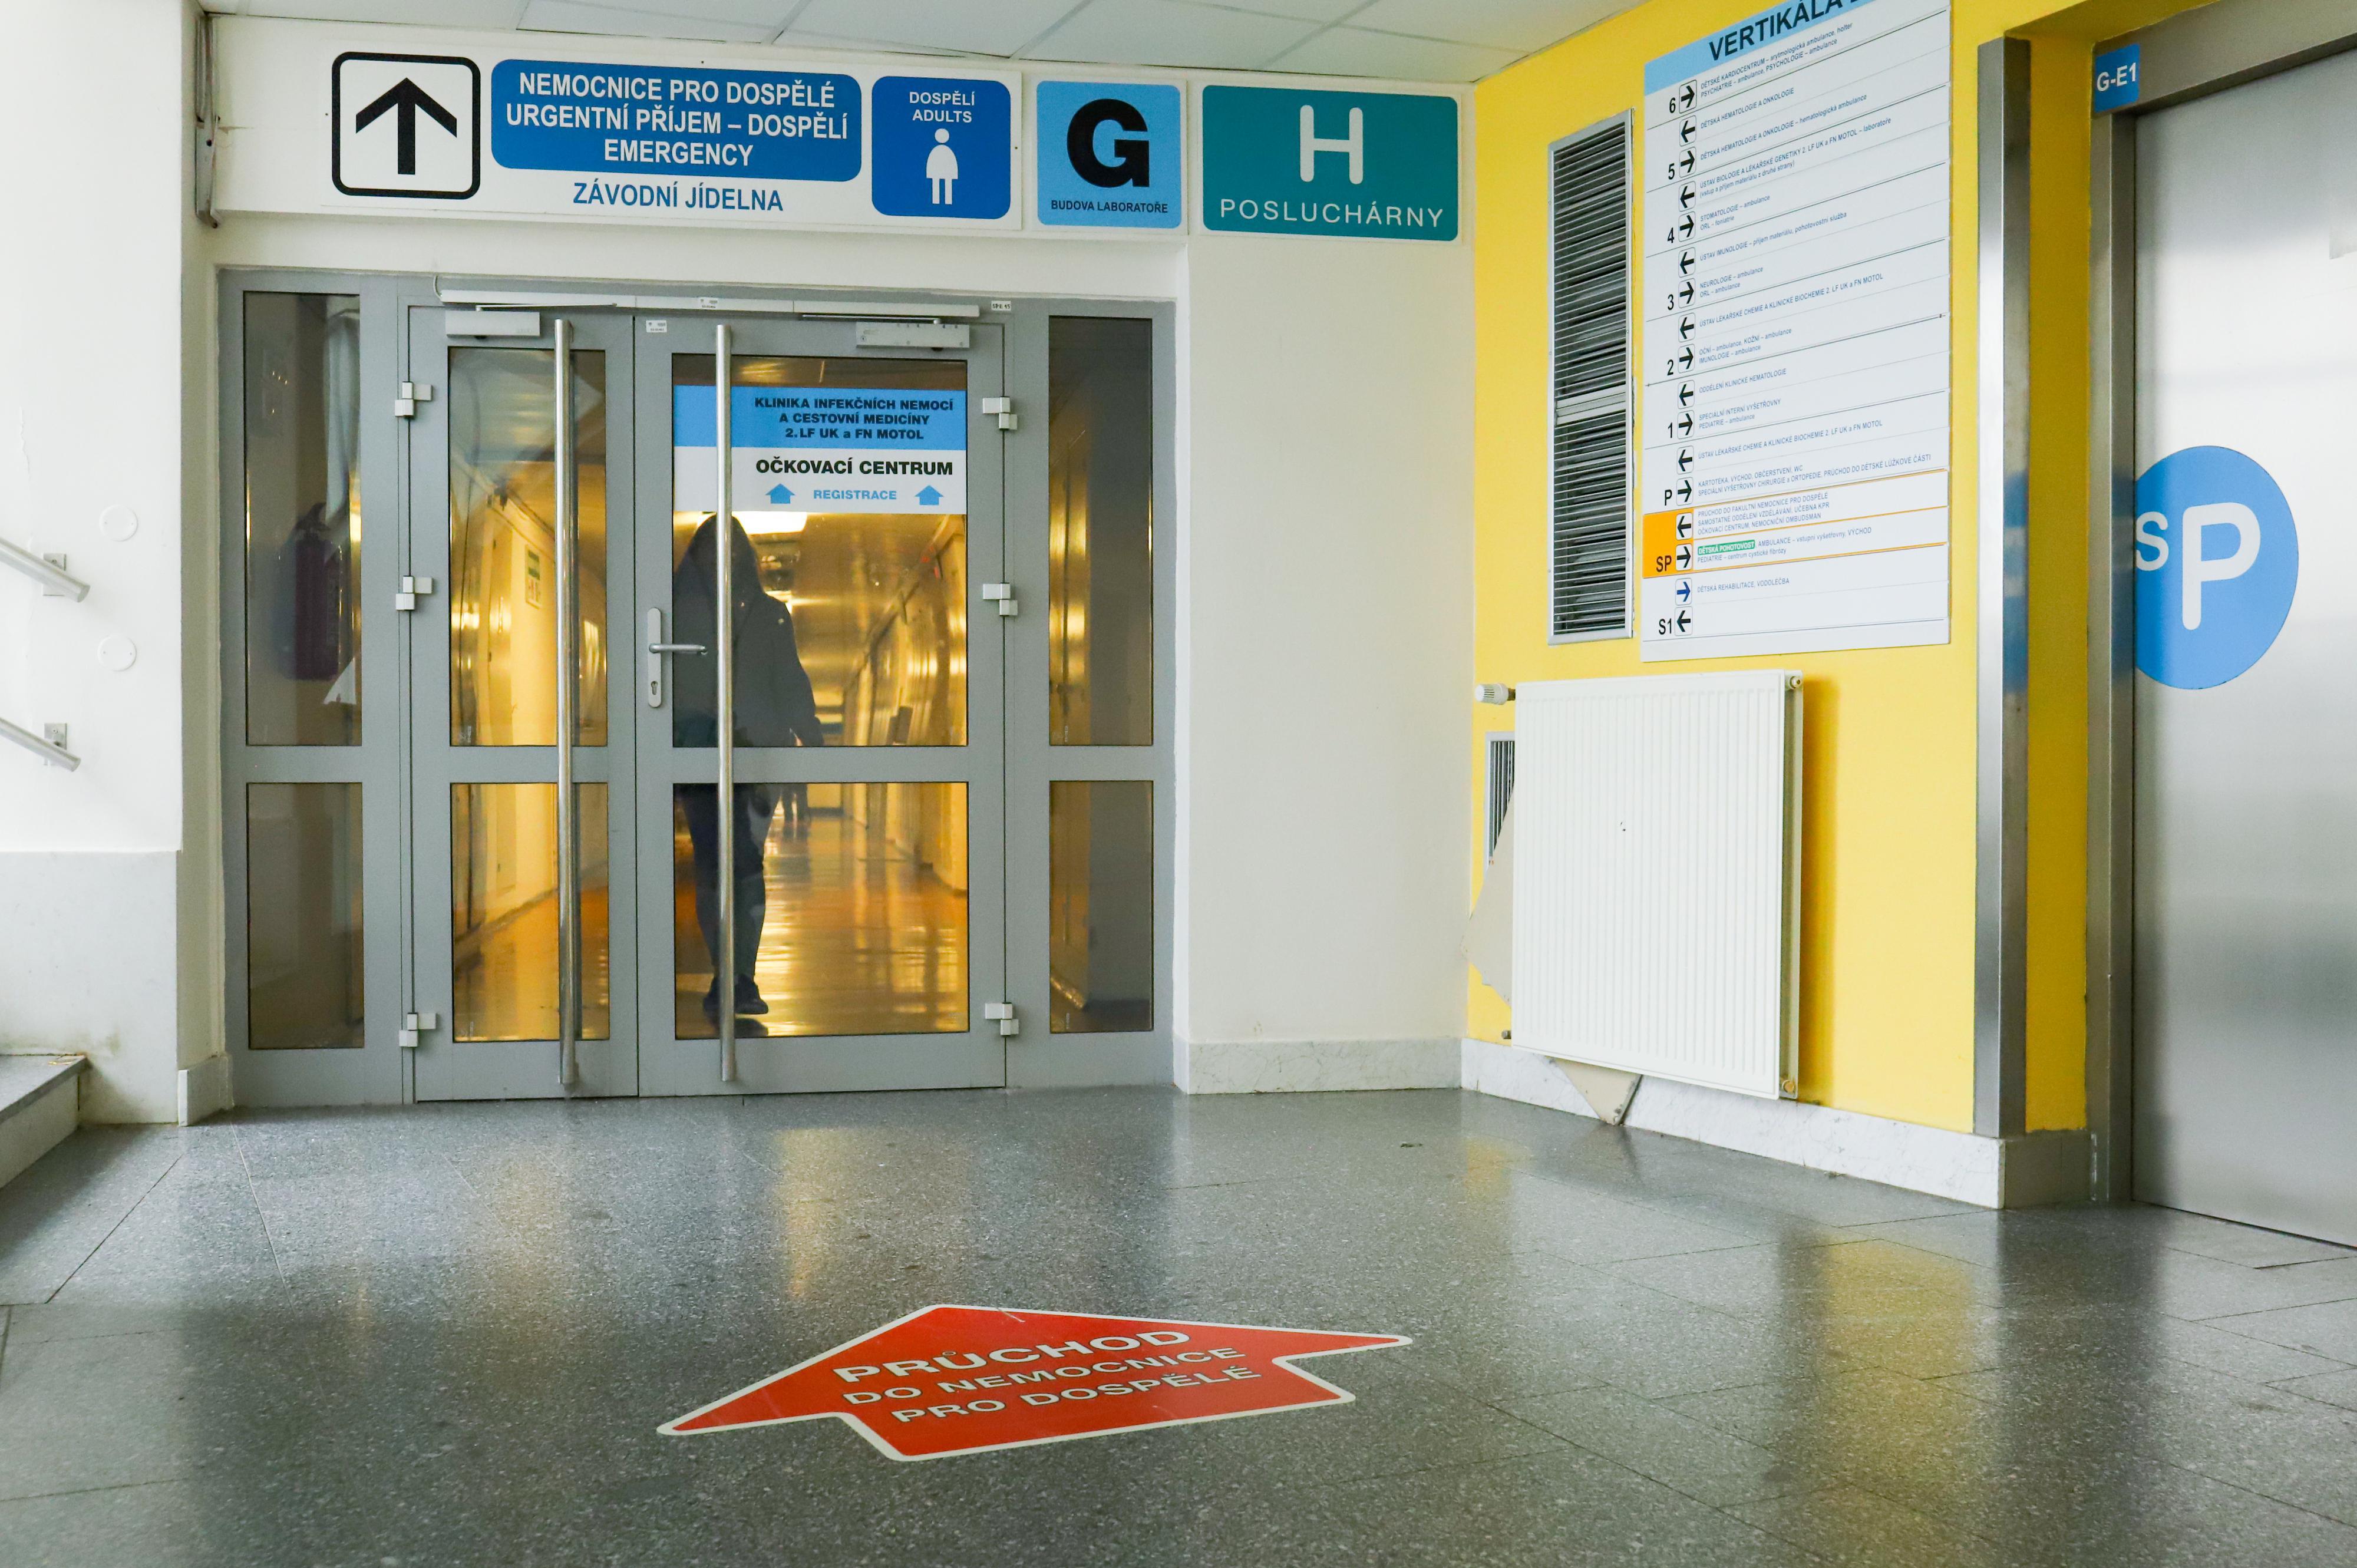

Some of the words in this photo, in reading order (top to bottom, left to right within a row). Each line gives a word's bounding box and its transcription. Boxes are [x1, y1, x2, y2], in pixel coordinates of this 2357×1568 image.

[1721, 57, 1765, 81] KARDIOCENTRUM
[1837, 23, 1852, 33] holter
[1701, 80, 1732, 97] PSYCHIATRIE
[1765, 51, 1803, 71] PSYCHOLOGIE
[1809, 38, 1837, 54] ambulance
[2097, 62, 2135, 91] G-E1
[520, 72, 662, 100] NEMOCNICE
[669, 80, 718, 103] PRO
[727, 80, 834, 108] DOSPĚLÉ
[910, 91, 974, 105] DOSPĚLÍ
[1669, 98, 1676, 114] 6
[1721, 101, 1757, 120] HEMATOLOGIE
[1762, 87, 1794, 104] ONKOLOGIE
[507, 104, 628, 130] URGENTNÍ
[636, 104, 720, 133] PŘÍJEM
[749, 112, 847, 138] DOSPĚLÍ
[913, 110, 972, 123] ADULTS
[1721, 134, 1757, 152] HEMATOLOGIE
[1762, 120, 1794, 137] ONKOLOGIE
[1838, 94, 1867, 110] ambulance
[1067, 99, 1149, 188] G
[1300, 105, 1363, 184] H
[605, 139, 753, 166] EMERGENCY
[1716, 169, 1740, 183] BIOLOGIE
[1774, 149, 1800, 163] GENETIKY
[1838, 129, 1857, 140] MOTOL
[1669, 163, 1675, 180] 5
[573, 179, 677, 207] ZÁVODNÍ
[685, 183, 783, 211] JÍDELNA
[1051, 200, 1094, 210] BUDOVA
[1098, 202, 1168, 213] LABORATOŘE
[1222, 199, 1442, 227] POSLUCHÁRNY
[1700, 204, 1738, 222] STOMATOLOGIE
[1744, 195, 1770, 207] ambulance
[1668, 227, 1675, 243] 4
[1716, 241, 1748, 255] IMUNOLOGIE
[1699, 274, 1732, 288] NEUROLOGIE
[1737, 267, 1763, 278] ambulance
[1715, 282, 1740, 293] ambulance
[1744, 304, 1763, 315] CHEMIE
[1794, 288, 1824, 302] BIOCHEMIE
[1863, 273, 1883, 283] MOTOL
[1668, 295, 1674, 311] 3
[1764, 328, 1792, 339] ambulance
[1699, 351, 1729, 363] IMUNOLOGIE
[1734, 345, 1761, 355] ambulance
[1668, 359, 1674, 376] 2
[1749, 368, 1786, 382] HEMATOLOGIE
[755, 398, 810, 408] KLINIKA
[815, 397, 895, 410] INFEKČNÍCH
[900, 399, 953, 410] NEMOCÍ
[780, 413, 788, 422] A
[793, 412, 859, 424] CESTOVNÍ
[864, 412, 929, 424] MEDICÍNY
[1699, 418, 1724, 429] PEDIATRIE
[1729, 414, 1755, 424] ambulance
[820, 428, 839, 438] UK
[856, 429, 872, 438] FN
[877, 430, 923, 439] MOTOL
[1668, 423, 1673, 438] 1
[1742, 441, 1762, 451] CHEMIE
[1794, 430, 1824, 442] BIOCHEMIE
[1862, 420, 1883, 428] MOTOL
[756, 457, 852, 474] OČKOVACÍ
[860, 461, 952, 475] CENTRUM
[1757, 476, 1785, 487] CHIRURGIE
[814, 490, 896, 500] REGISTRACE
[1665, 490, 1672, 506] P
[1757, 498, 1788, 509] NEMOCNICE
[1785, 513, 1821, 523] OMBUDSMAN
[1719, 541, 1754, 552] POHOTOVOST
[1758, 537, 1791, 546] AMBULANCE
[1656, 556, 1672, 572] SP
[1697, 554, 1722, 563] PEDIATRIE
[1659, 619, 1672, 635] S1
[833, 1331, 1190, 1382] PRŮCHOD
[843, 1387, 922, 1405] DO
[937, 1347, 1246, 1392] NEMOCNICE
[891, 1400, 1005, 1423] PRO
[1019, 1364, 1262, 1405] DOSPĚLÉ
